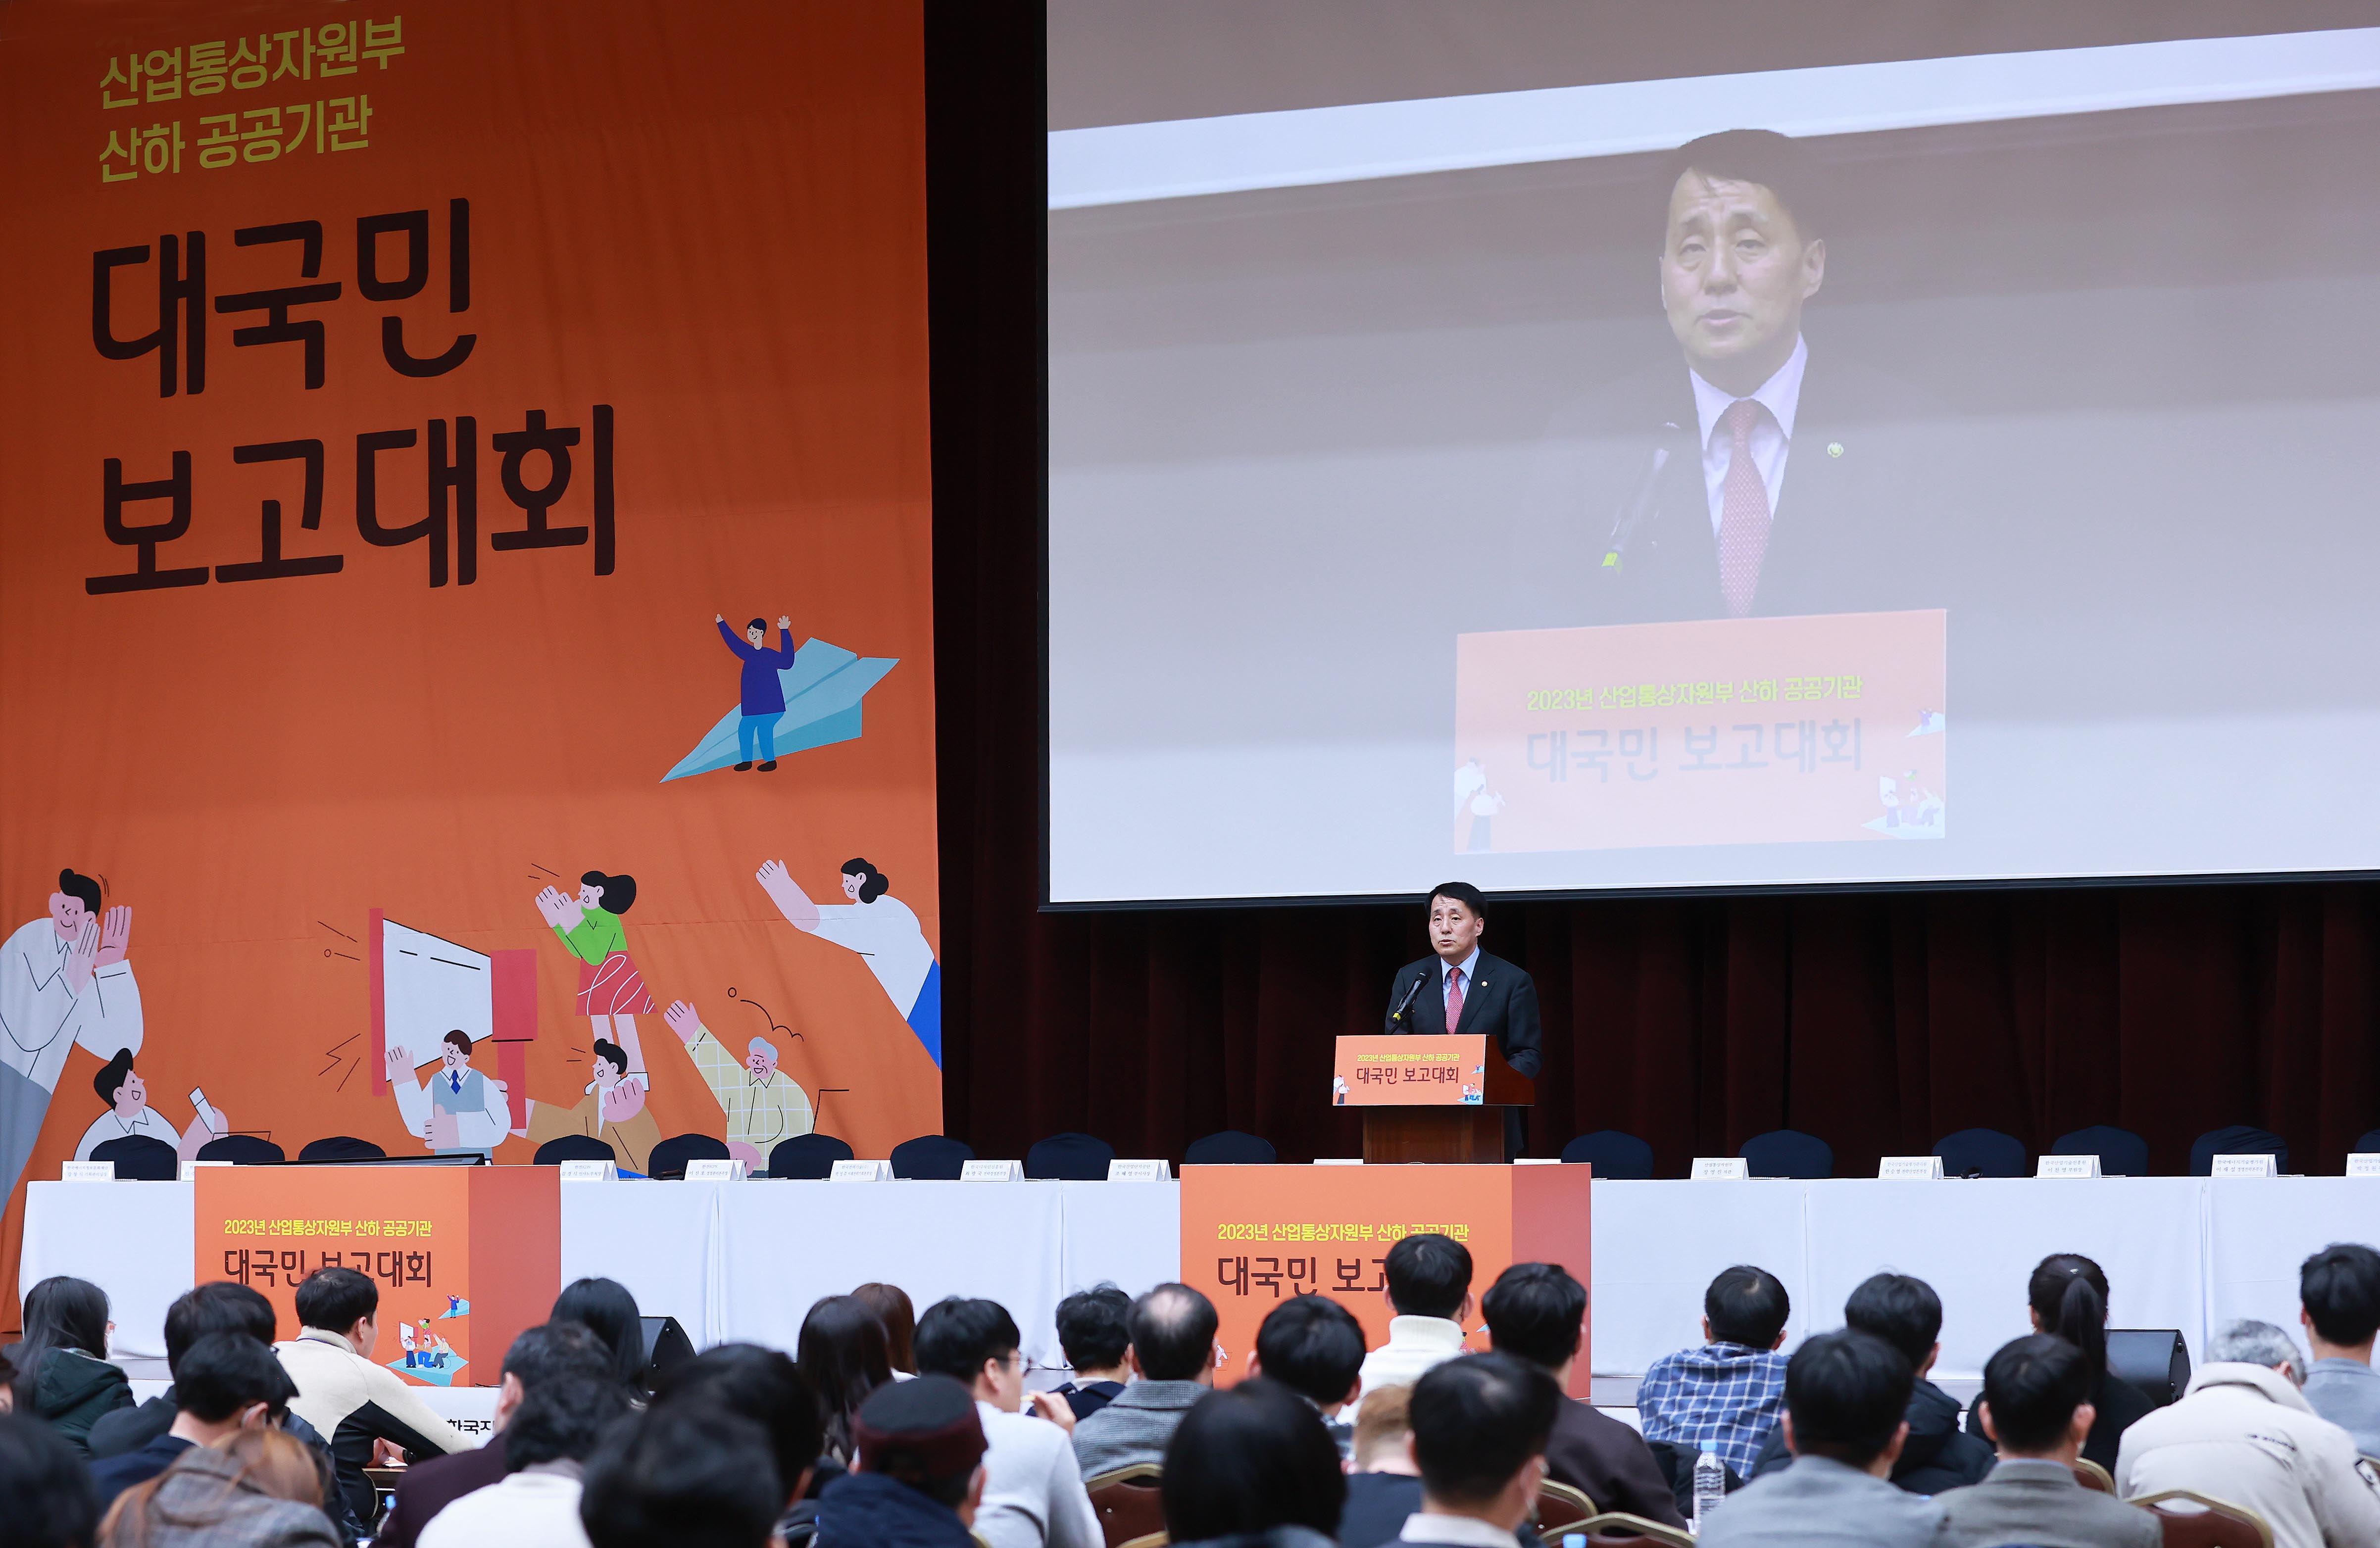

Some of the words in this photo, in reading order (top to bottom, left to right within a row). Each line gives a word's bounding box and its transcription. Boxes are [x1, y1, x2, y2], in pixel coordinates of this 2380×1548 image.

[99, 15, 406, 109] 산업통상자원부
[99, 120, 186, 183] 산하
[198, 95, 373, 169] 공공기관
[92, 197, 477, 398] 대국민
[85, 404, 615, 596] 보고대회
[1527, 687, 1593, 711] 2023년
[1599, 681, 1734, 710] 산업통상자원부
[1739, 678, 1779, 703] 산하
[1784, 675, 1864, 702] 공공기관
[1527, 726, 1658, 783] 대국민
[1679, 717, 1862, 774] 보고대회
[1356, 1067, 1397, 1085] 대국민
[1402, 1066, 1459, 1084] 보고대회
[1380, 1054, 1422, 1062] 산업통상자원부
[1436, 1053, 1460, 1062] 공공기관
[224, 1219, 266, 1236] 2023년
[268, 1219, 352, 1236] 산업통상자원부
[355, 1220, 380, 1237] 산하
[383, 1220, 433, 1237] 공공기관
[1217, 1223, 1268, 1241] 2023년
[1272, 1223, 1374, 1242] 산업통상자원부
[1377, 1224, 1407, 1242] 산하
[224, 1249, 305, 1287] 대국민
[1218, 1256, 1318, 1298] 대국민
